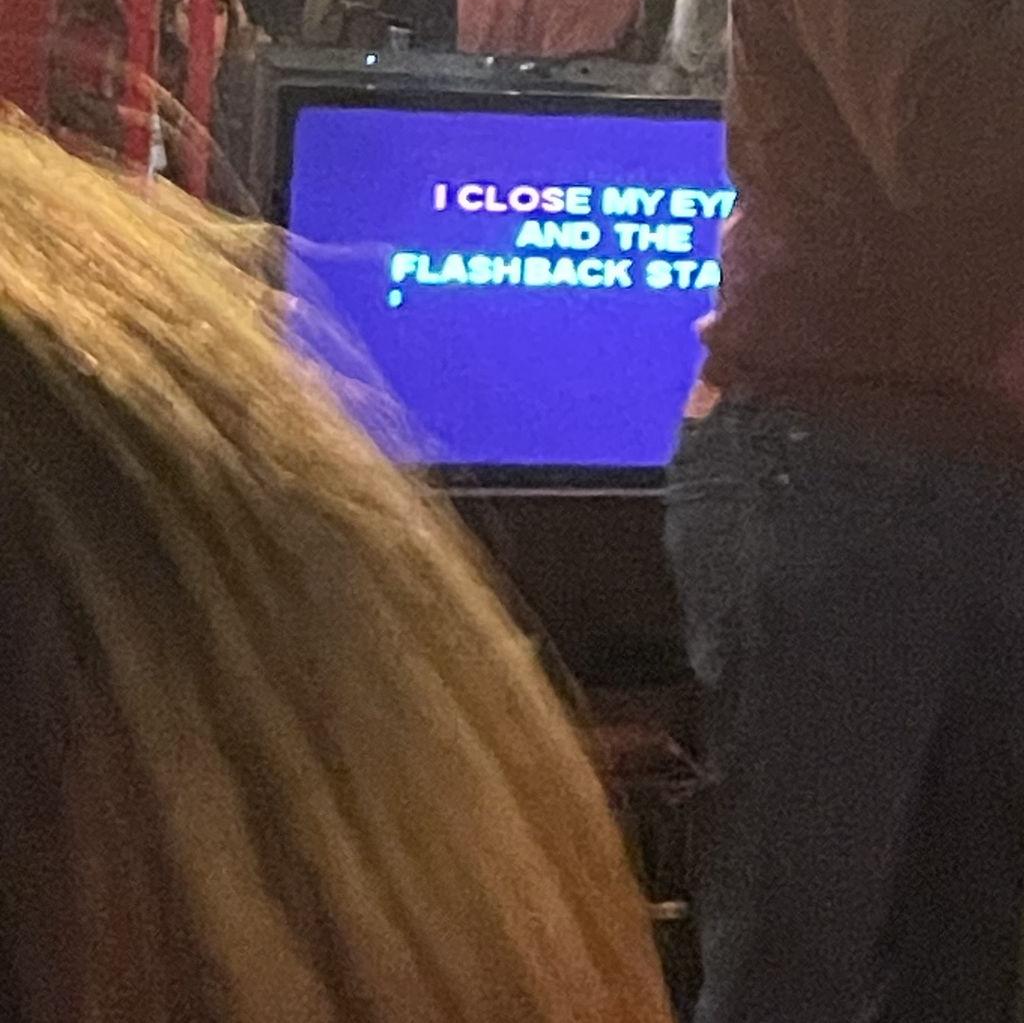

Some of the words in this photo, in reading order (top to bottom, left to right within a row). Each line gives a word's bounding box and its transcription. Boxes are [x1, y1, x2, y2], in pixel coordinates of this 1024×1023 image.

[433, 182, 448, 212] I
[457, 183, 592, 215] CLOSE
[602, 186, 665, 216] MY
[515, 220, 600, 250] AND
[614, 222, 693, 253] THE
[391, 252, 632, 288] FLASHBACK
